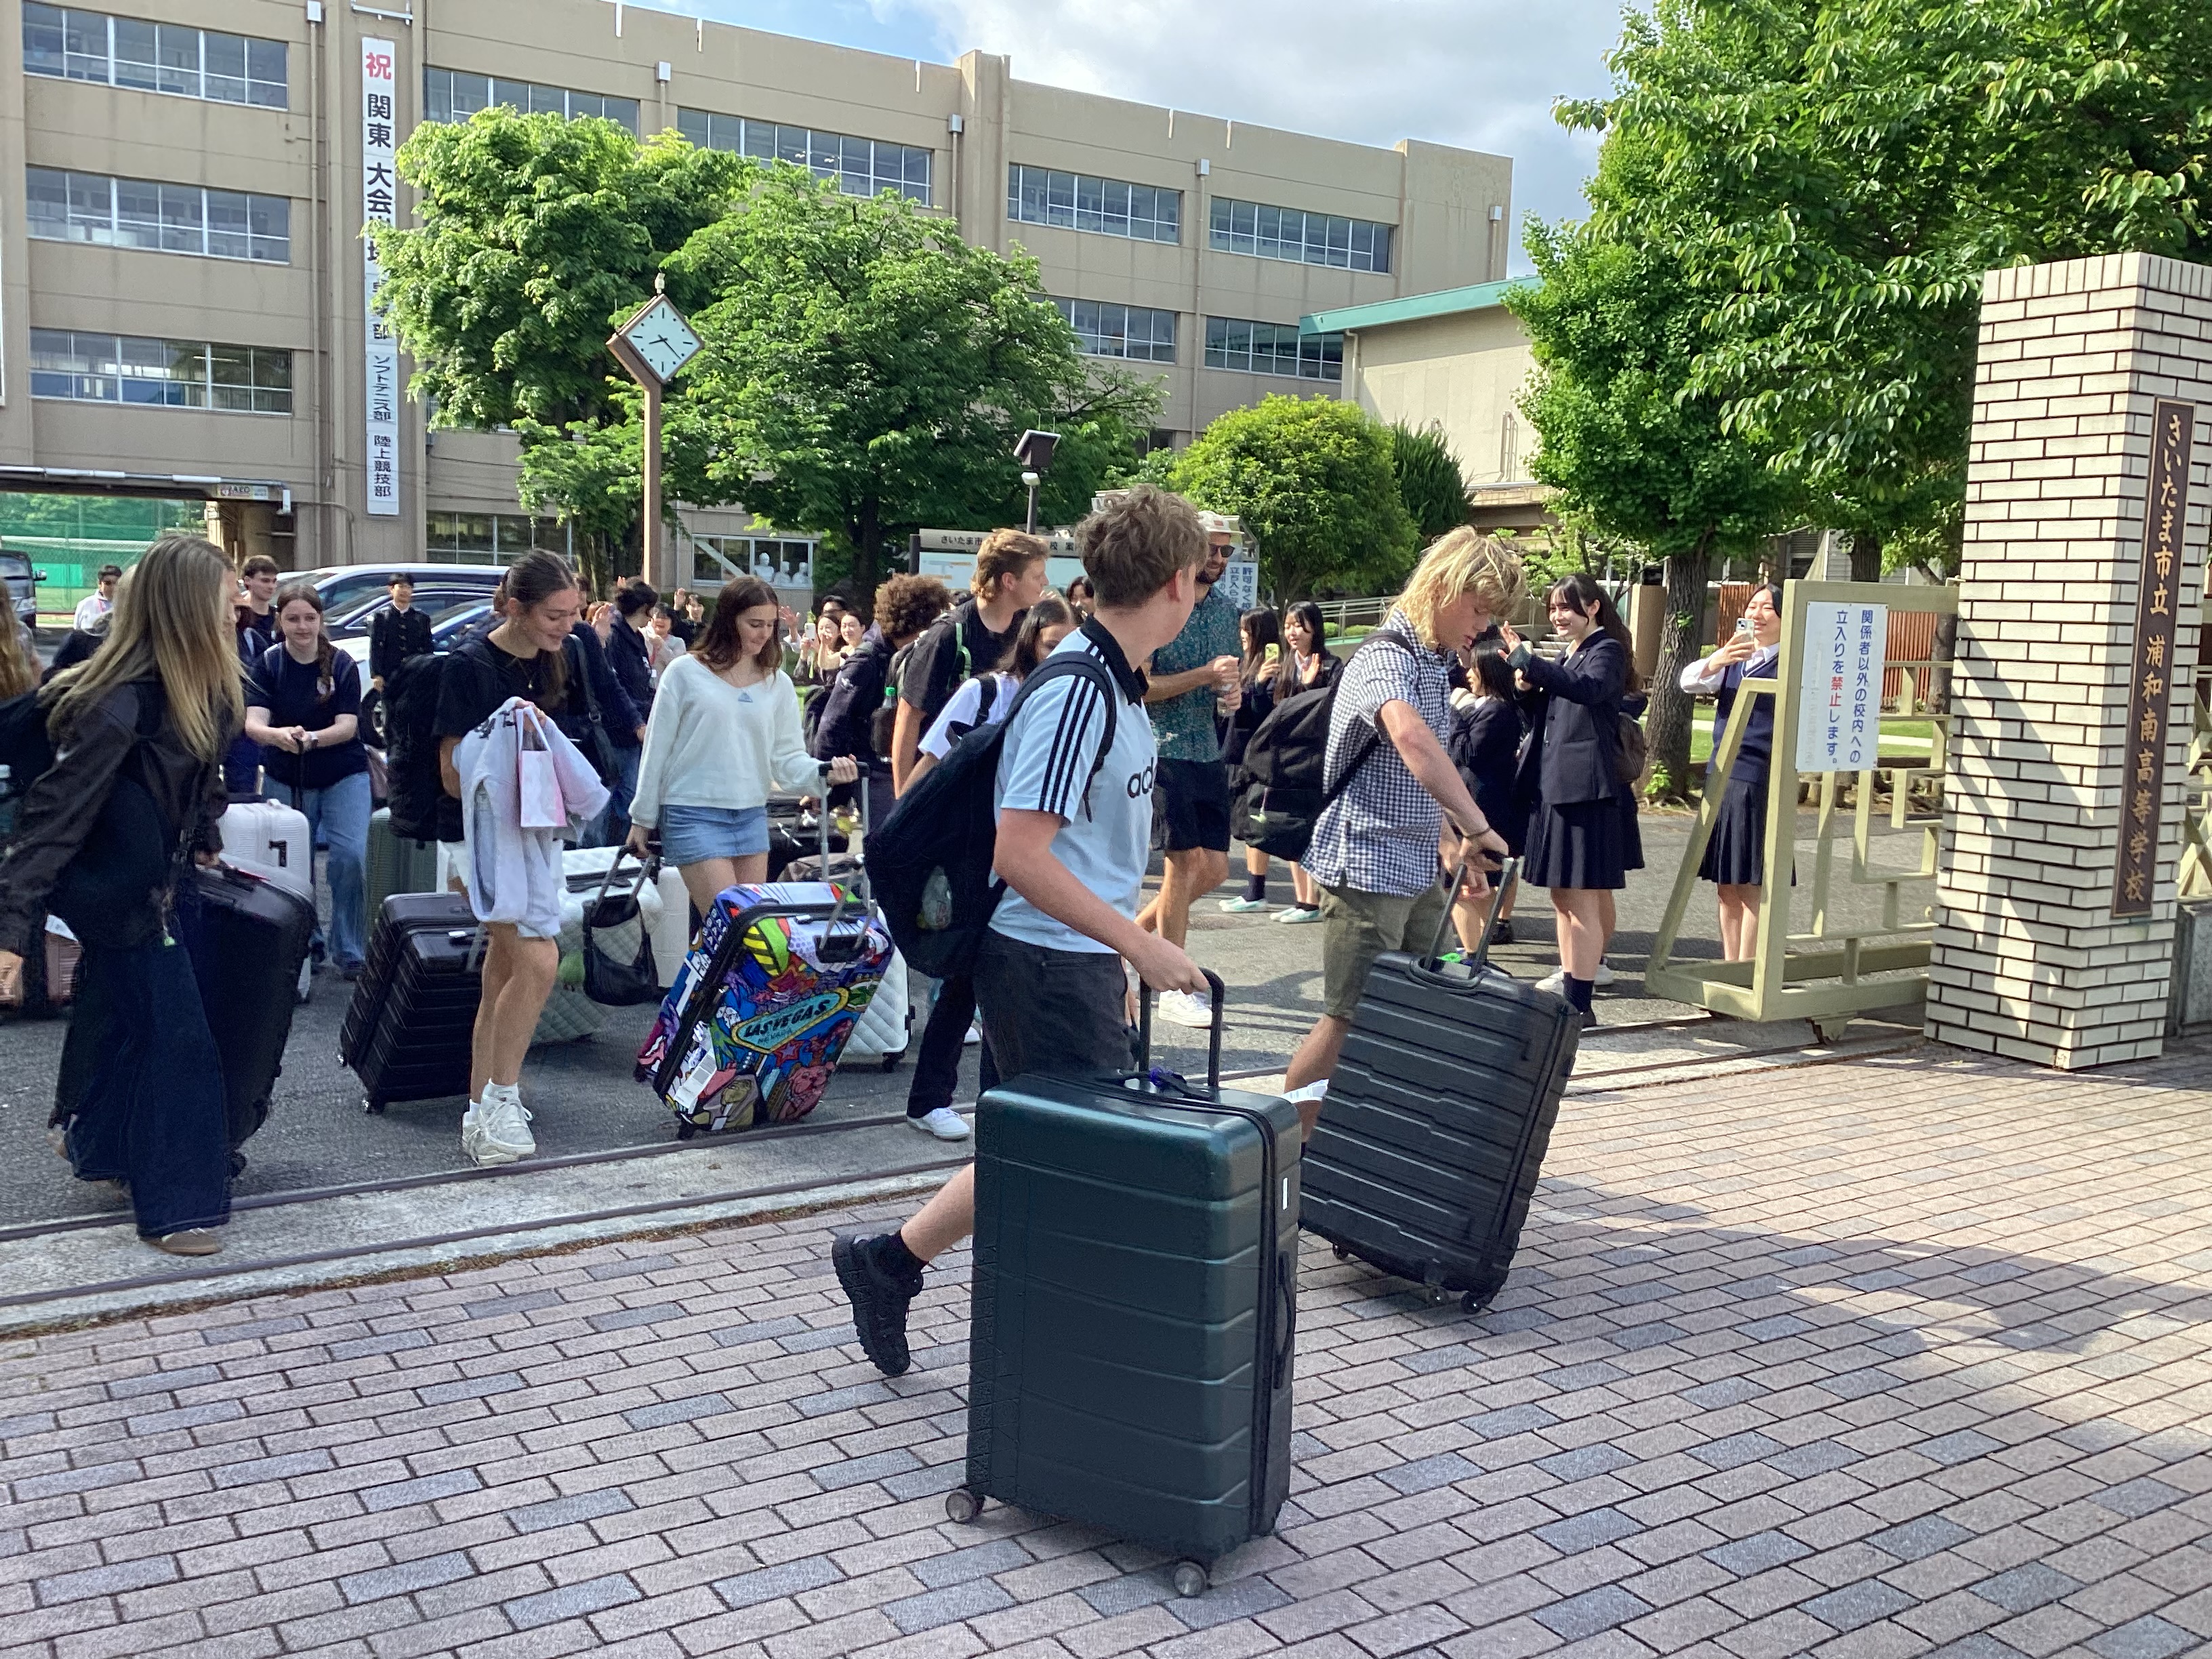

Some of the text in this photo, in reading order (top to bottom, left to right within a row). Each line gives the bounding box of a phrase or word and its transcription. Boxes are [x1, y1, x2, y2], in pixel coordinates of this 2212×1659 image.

[365, 52, 392, 81] 祝
[372, 354, 391, 421] ソフトテニス部
[373, 434, 392, 497] 陸上競技部
[1826, 609, 1849, 764] 立入りを禁止します。
[1850, 609, 1873, 764] 関係者以外の校内への
[2125, 414, 2182, 902] さいたま市立 浦和南高等学校
[743, 999, 831, 1038] LAS VEGAS
